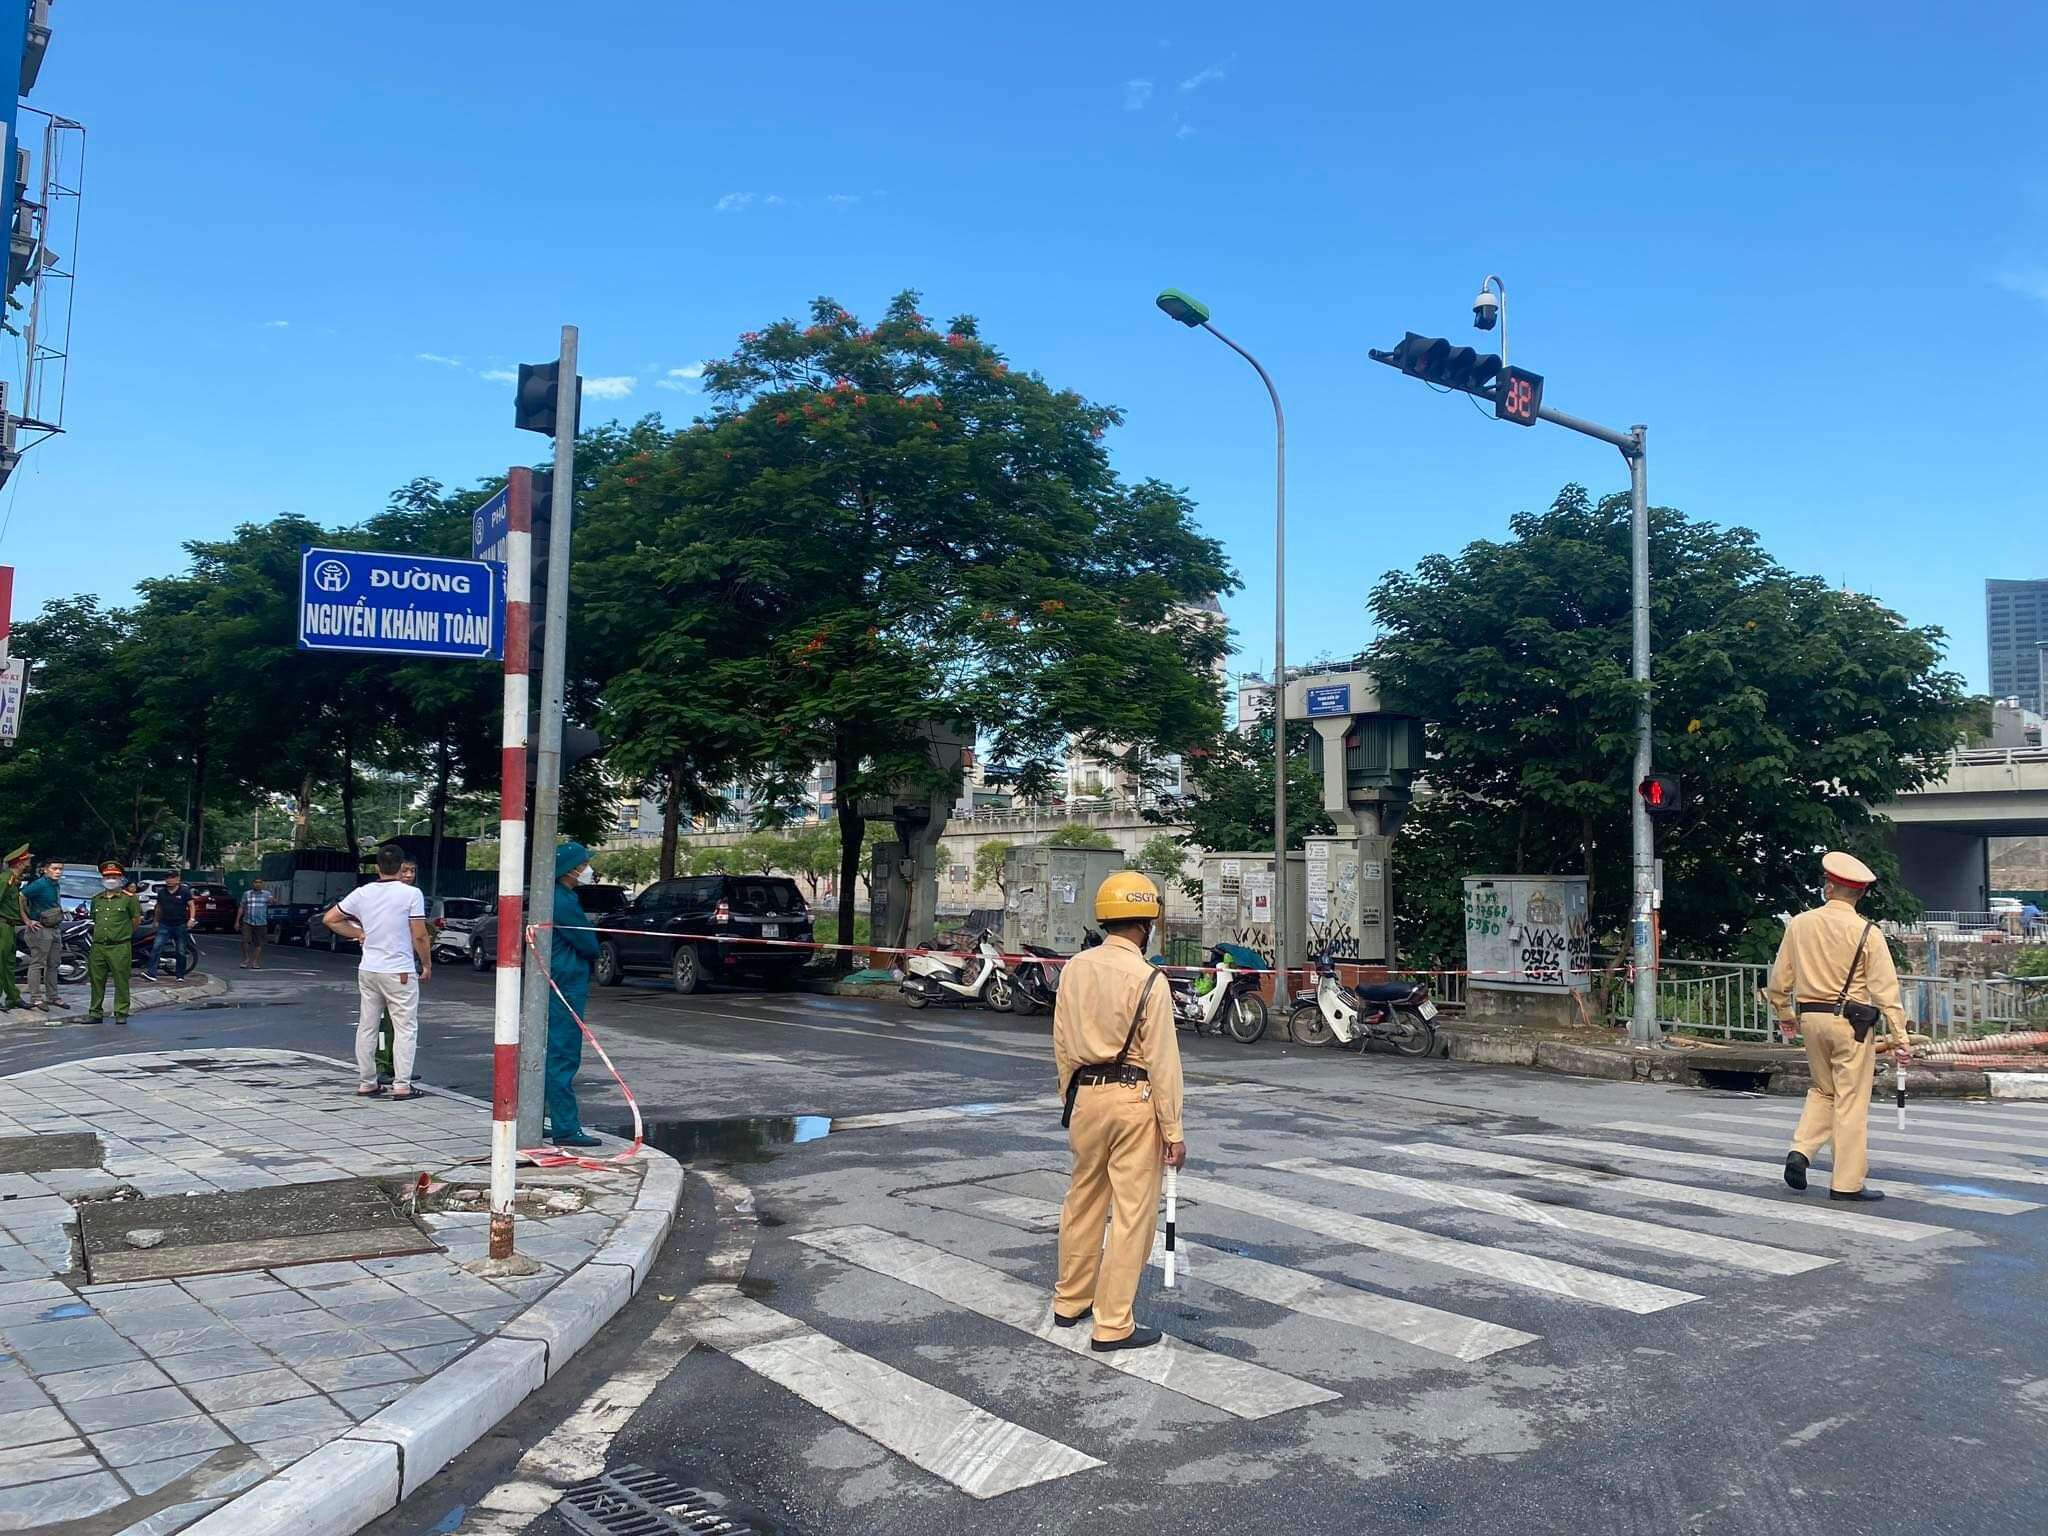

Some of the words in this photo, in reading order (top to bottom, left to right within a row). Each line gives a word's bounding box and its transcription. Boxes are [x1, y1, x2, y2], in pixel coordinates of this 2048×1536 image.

[369, 567, 471, 594] ĐƯỜNG
[305, 596, 377, 638] NGUYỄN
[381, 603, 439, 642] KHÁNH
[443, 607, 489, 645] TOÀN
[1126, 892, 1155, 903] CSGT
